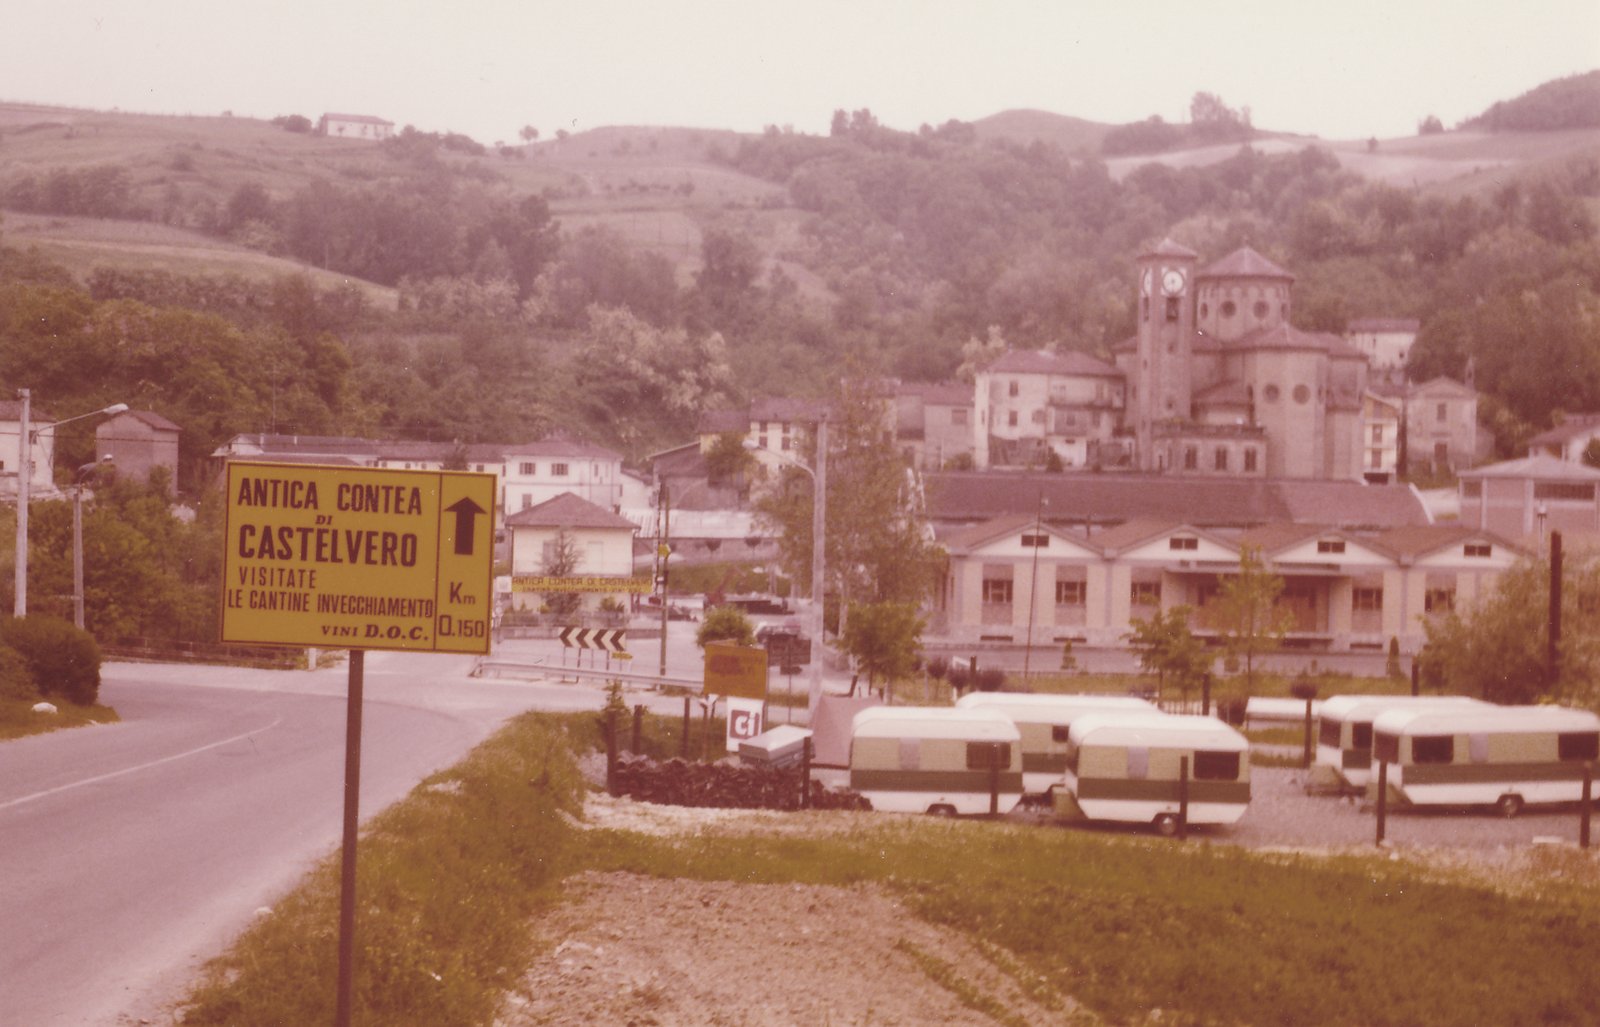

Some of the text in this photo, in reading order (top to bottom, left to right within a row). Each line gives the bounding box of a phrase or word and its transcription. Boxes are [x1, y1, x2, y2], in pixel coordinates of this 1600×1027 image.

[237, 477, 423, 515] ANTICA CONTEA
[315, 515, 333, 526] DI
[238, 524, 418, 567] CASTELVERO
[238, 566, 317, 589] VISITATE
[228, 589, 433, 618] LE CANTINE INVECCHIAMENTO
[450, 581, 476, 605] Km
[321, 624, 429, 641] VINI D.O.C.
[438, 614, 485, 639] 0.150
